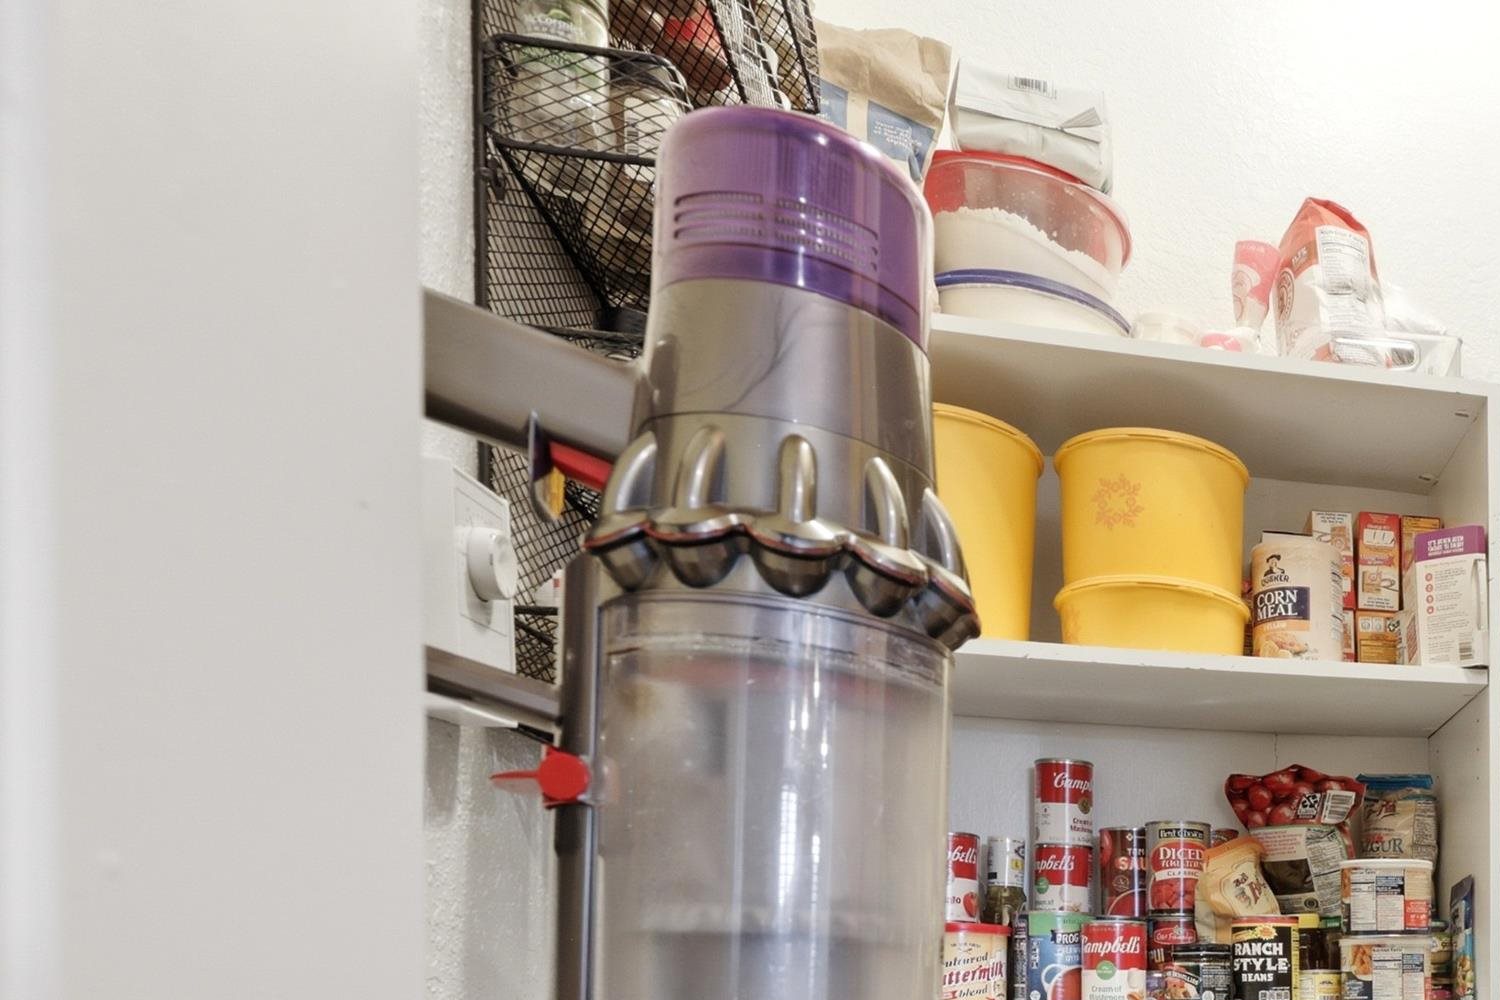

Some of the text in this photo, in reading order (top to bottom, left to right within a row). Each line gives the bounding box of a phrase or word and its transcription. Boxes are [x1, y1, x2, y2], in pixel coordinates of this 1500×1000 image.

[1261, 574, 1289, 586] QUAKER
[1257, 589, 1299, 607] CORN
[1257, 603, 1299, 621] MEAL
[1117, 857, 1146, 870] SAU
[1234, 942, 1284, 956] RANCH
[1233, 958, 1290, 972] STYLE
[1242, 973, 1275, 983] BEANS
[959, 985, 988, 998] blend
[1091, 985, 1112, 993] Cream
